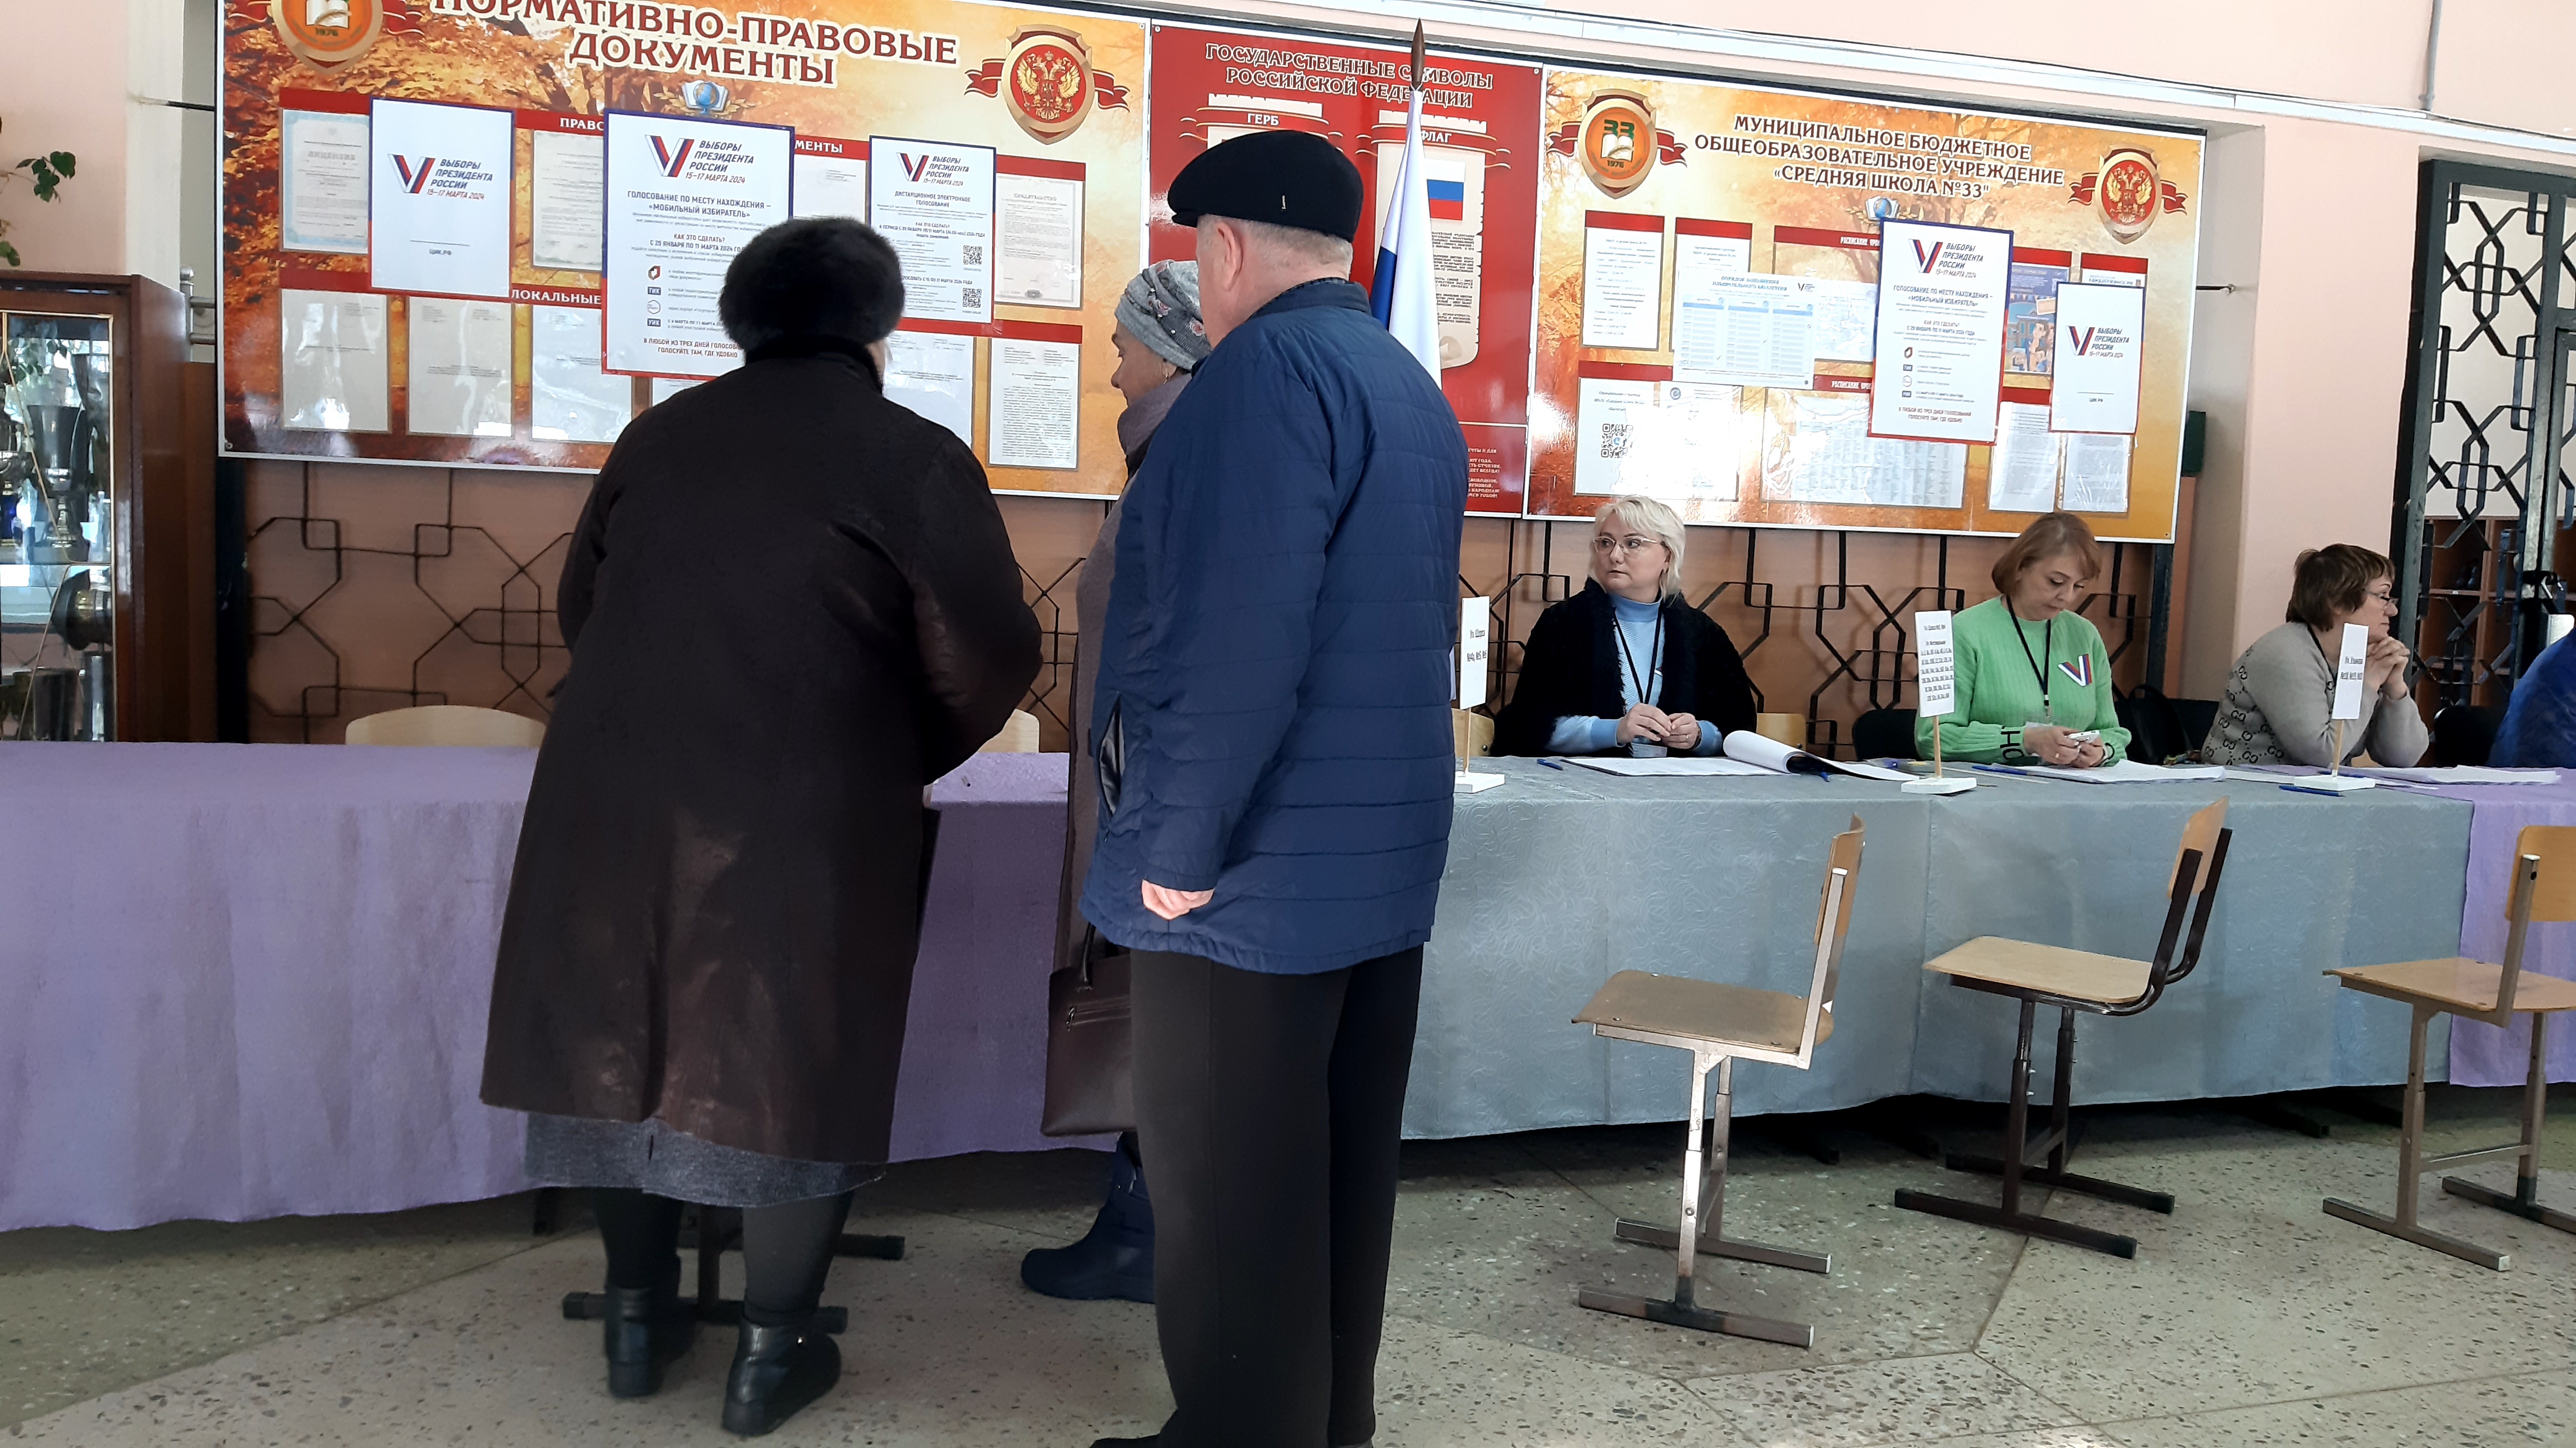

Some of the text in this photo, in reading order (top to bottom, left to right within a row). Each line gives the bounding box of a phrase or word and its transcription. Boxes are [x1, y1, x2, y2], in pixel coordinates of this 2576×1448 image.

[569, 33, 833, 84] ДОКУМЕНТЫ
[1206, 43, 1494, 90] ГОСУДАРСТВЕННЫЕ СМВОЛЫ
[1226, 67, 1473, 109] РОССИЙСКОЙ ФЕДЕАЦИИ
[1247, 113, 1279, 125] ГЕРБ
[1421, 130, 1452, 142] ФЛАГ
[1734, 116, 2030, 160] МУНИЦИПАЛЬНОЕ БЮДЖЕТНОЕ
[699, 141, 742, 152] ВЫБОРЫ
[694, 151, 754, 164] ПРЕЗИДЕНТА
[1695, 135, 2063, 185] ОБЩЕОБРАЗОВАТЕЛЬНОЕ УЧРЕЖДЕНИЕ
[440, 159, 481, 169] ВЫБОРЫ
[689, 162, 729, 173] РОССИИ
[929, 163, 969, 172] ПРЕЗИДЕНТА
[435, 169, 493, 181] ПРЕЗИДЕНТА
[705, 174, 727, 182] МАРТА
[729, 176, 745, 184] 2024
[1774, 165, 1866, 187] «СРЕДНЯЯ
[1872, 174, 1937, 194] ШКОЛА
[431, 179, 468, 189] РОССИИ
[628, 191, 678, 201] ГОЛОСОВАНИЕ
[692, 196, 714, 205] МЕСТУ
[717, 198, 764, 209] НАХОЖДЕНИЯ
[649, 203, 750, 217] «МОБИЛЬНЫЙ ИЗБИРАТЕЛЬ»
[1946, 243, 1976, 251] ВЫБОРЫ
[1942, 251, 1983, 262] ПРЕЗИДЕНТА
[1938, 261, 1965, 269] РОССИИ
[511, 289, 601, 305] ЛОКАЛЬНЫЕ
